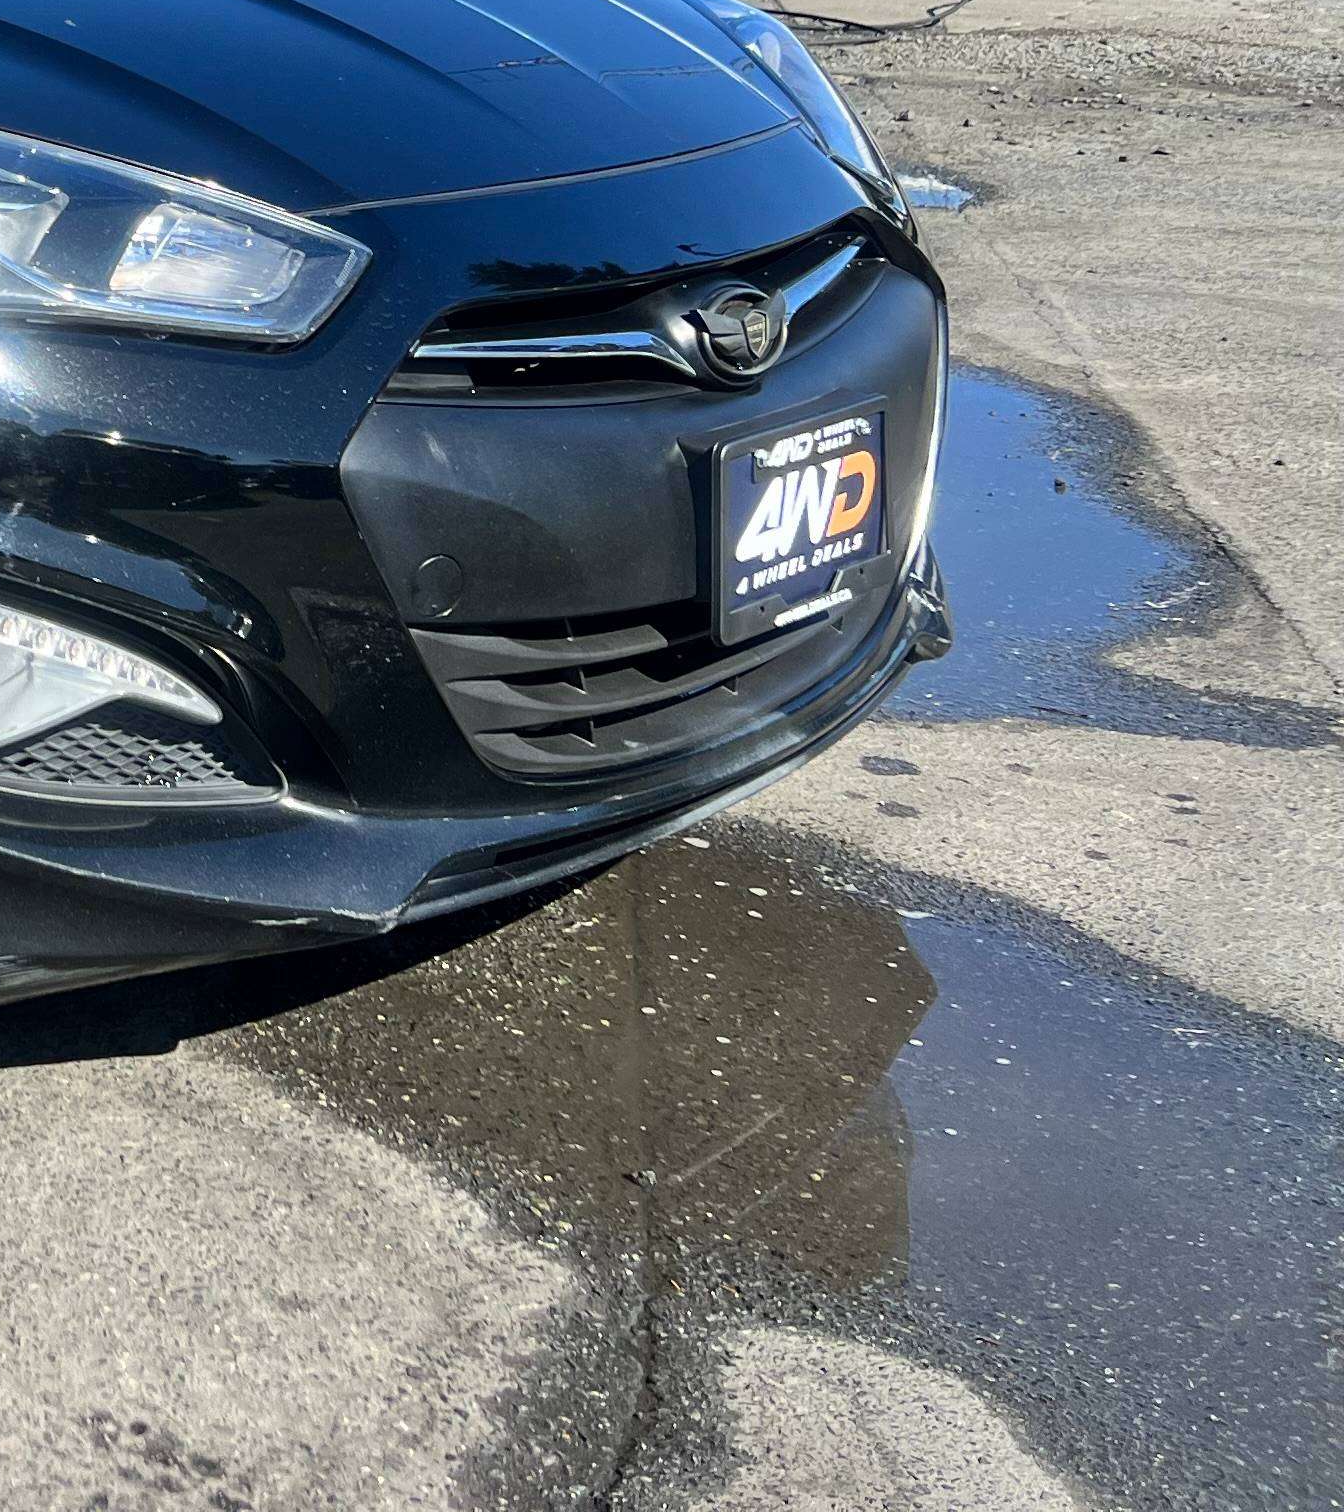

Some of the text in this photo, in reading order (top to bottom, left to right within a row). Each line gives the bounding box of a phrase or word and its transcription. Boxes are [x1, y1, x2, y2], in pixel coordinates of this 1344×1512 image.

[735, 450, 876, 563] 4WD
[735, 532, 864, 596] 4 WHEEL DEALS
